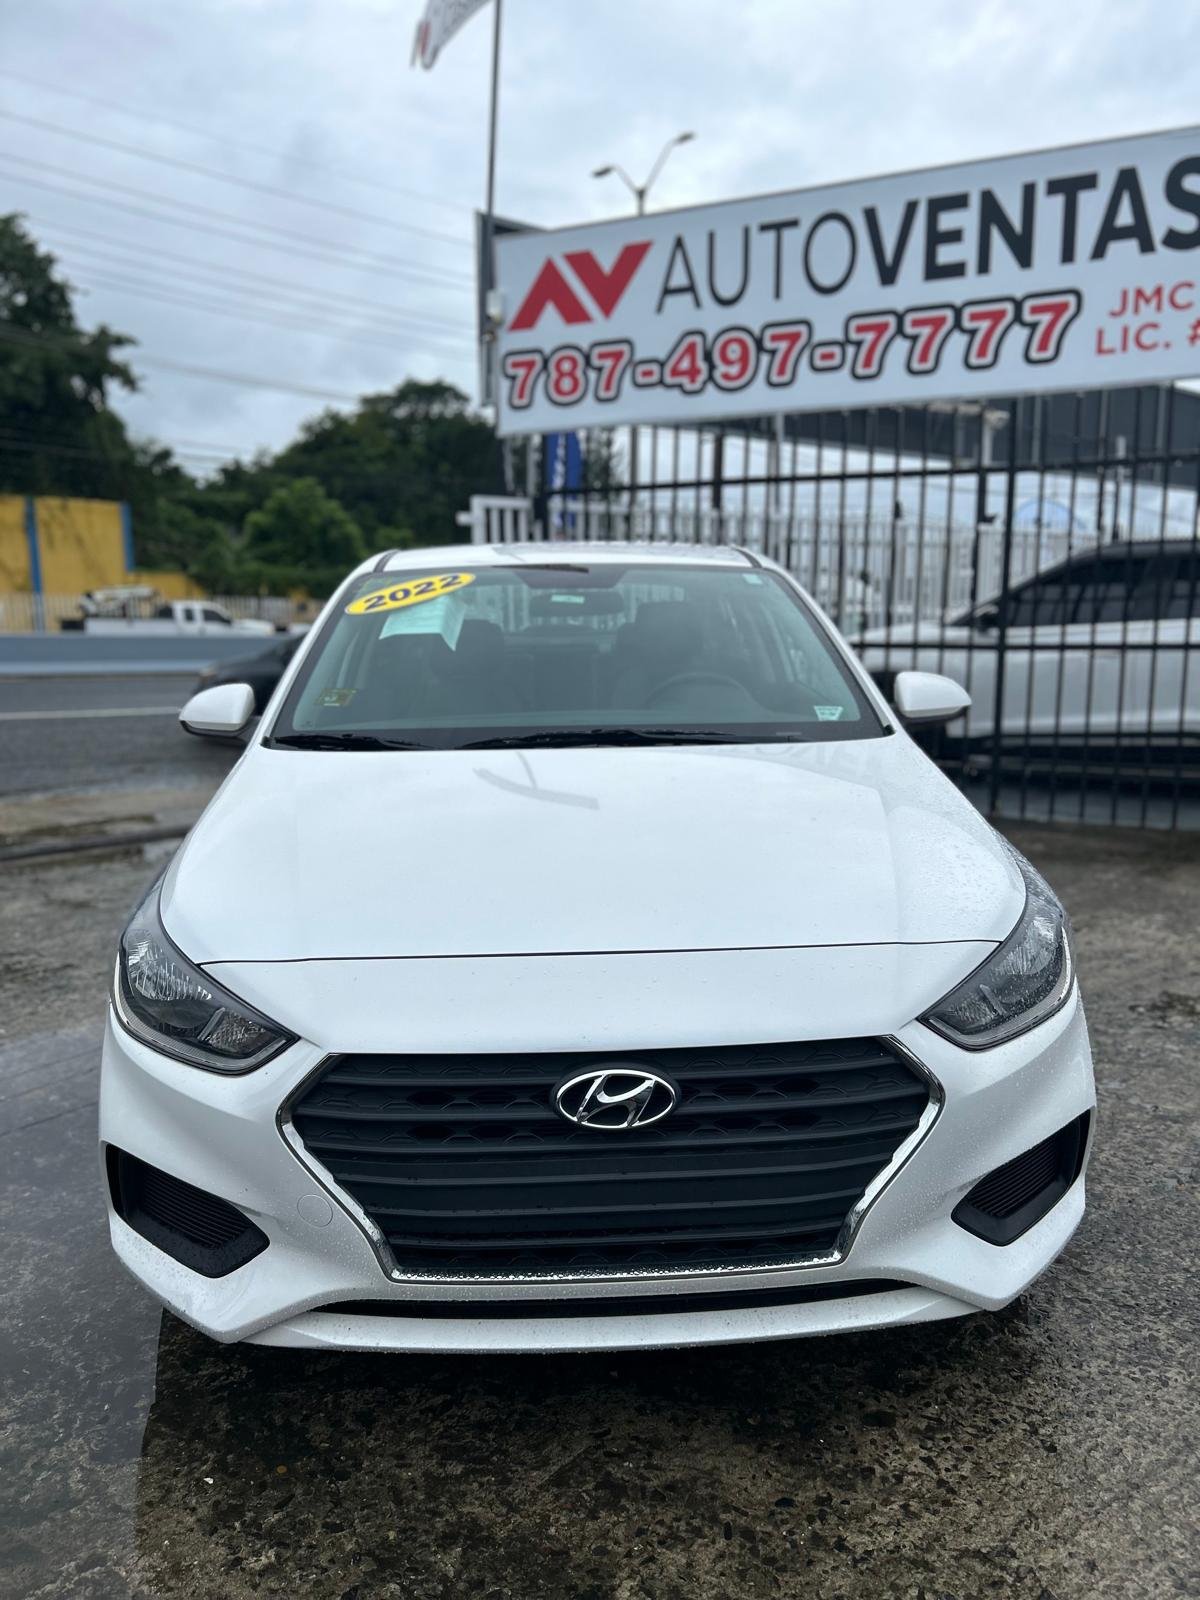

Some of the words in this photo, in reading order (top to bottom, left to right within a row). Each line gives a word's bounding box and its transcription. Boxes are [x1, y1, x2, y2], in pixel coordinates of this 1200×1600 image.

[656, 155, 1200, 314] AUTOVENTAS
[1109, 281, 1195, 317] JMC
[503, 287, 1082, 408] 787-497-7777
[1096, 322, 1171, 355] LIC.
[364, 574, 462, 611] 2022
